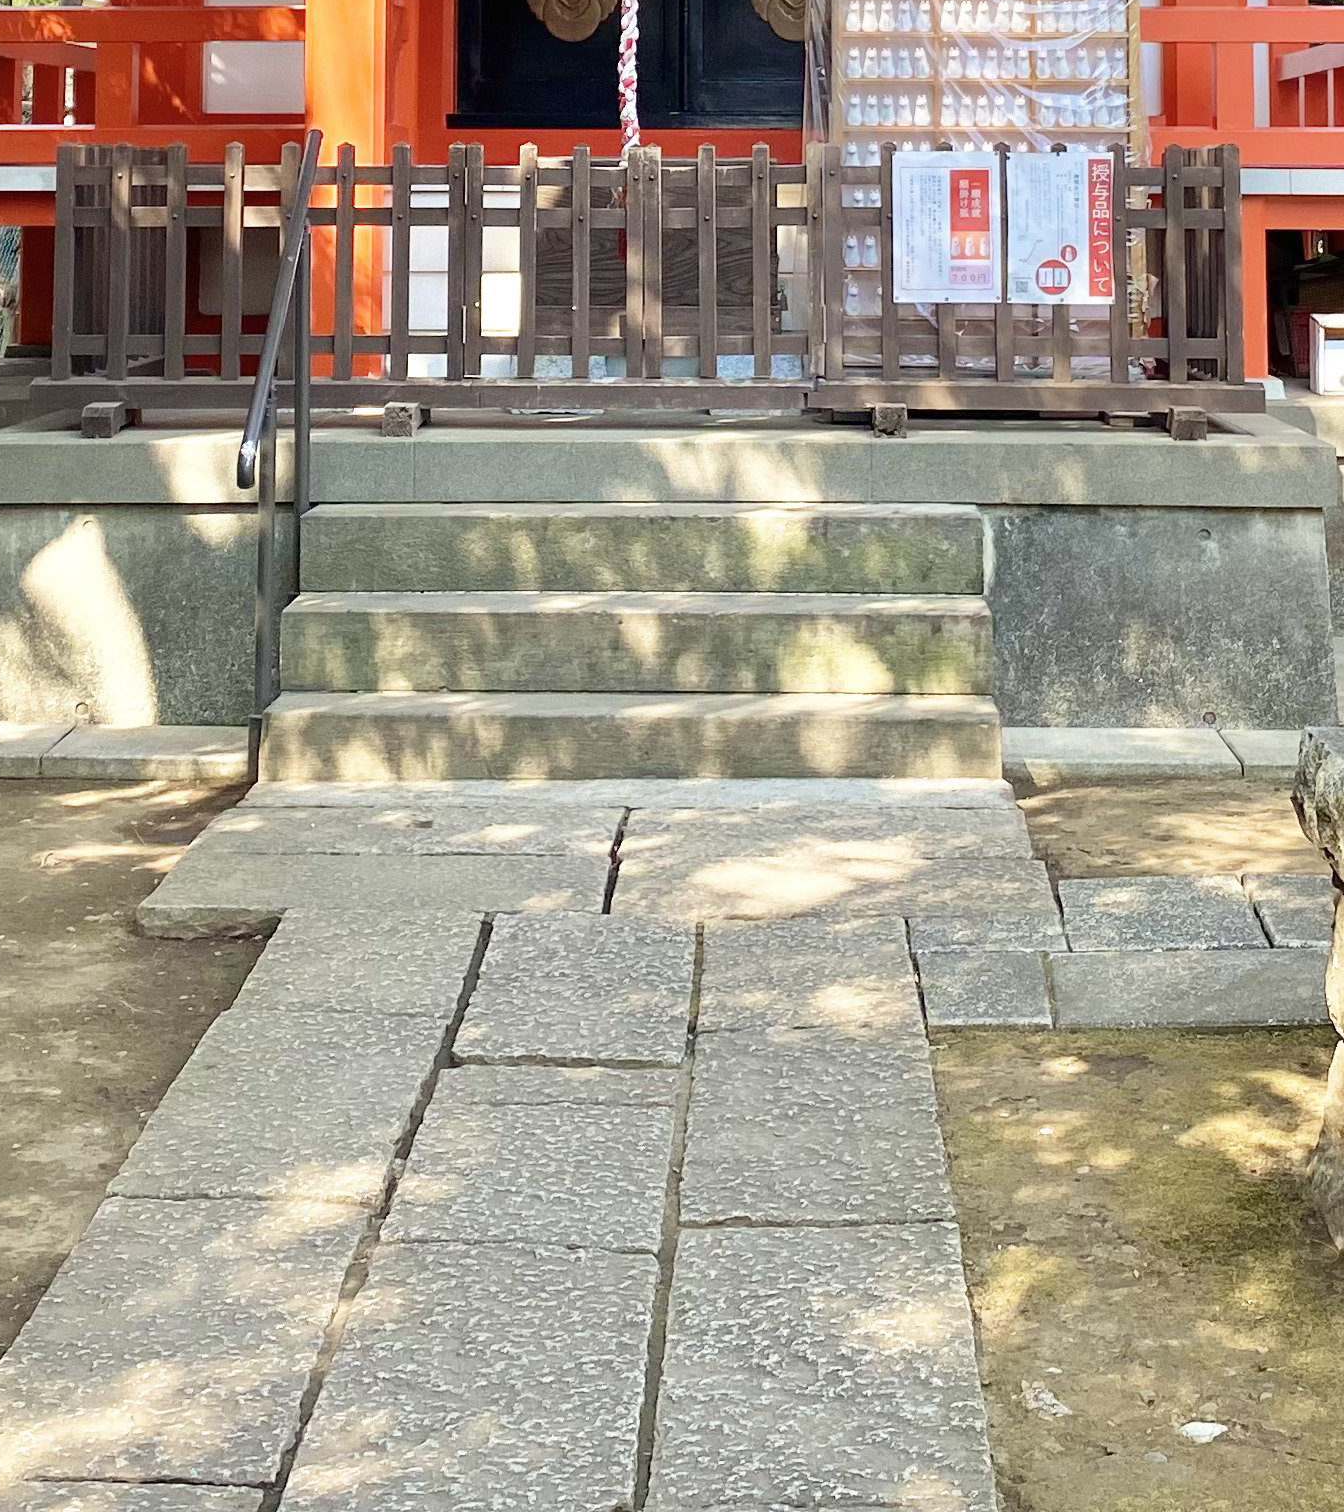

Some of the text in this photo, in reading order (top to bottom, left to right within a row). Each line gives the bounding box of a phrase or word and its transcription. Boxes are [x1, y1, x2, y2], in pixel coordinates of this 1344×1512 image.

[1091, 163, 1111, 293] 授与品について
